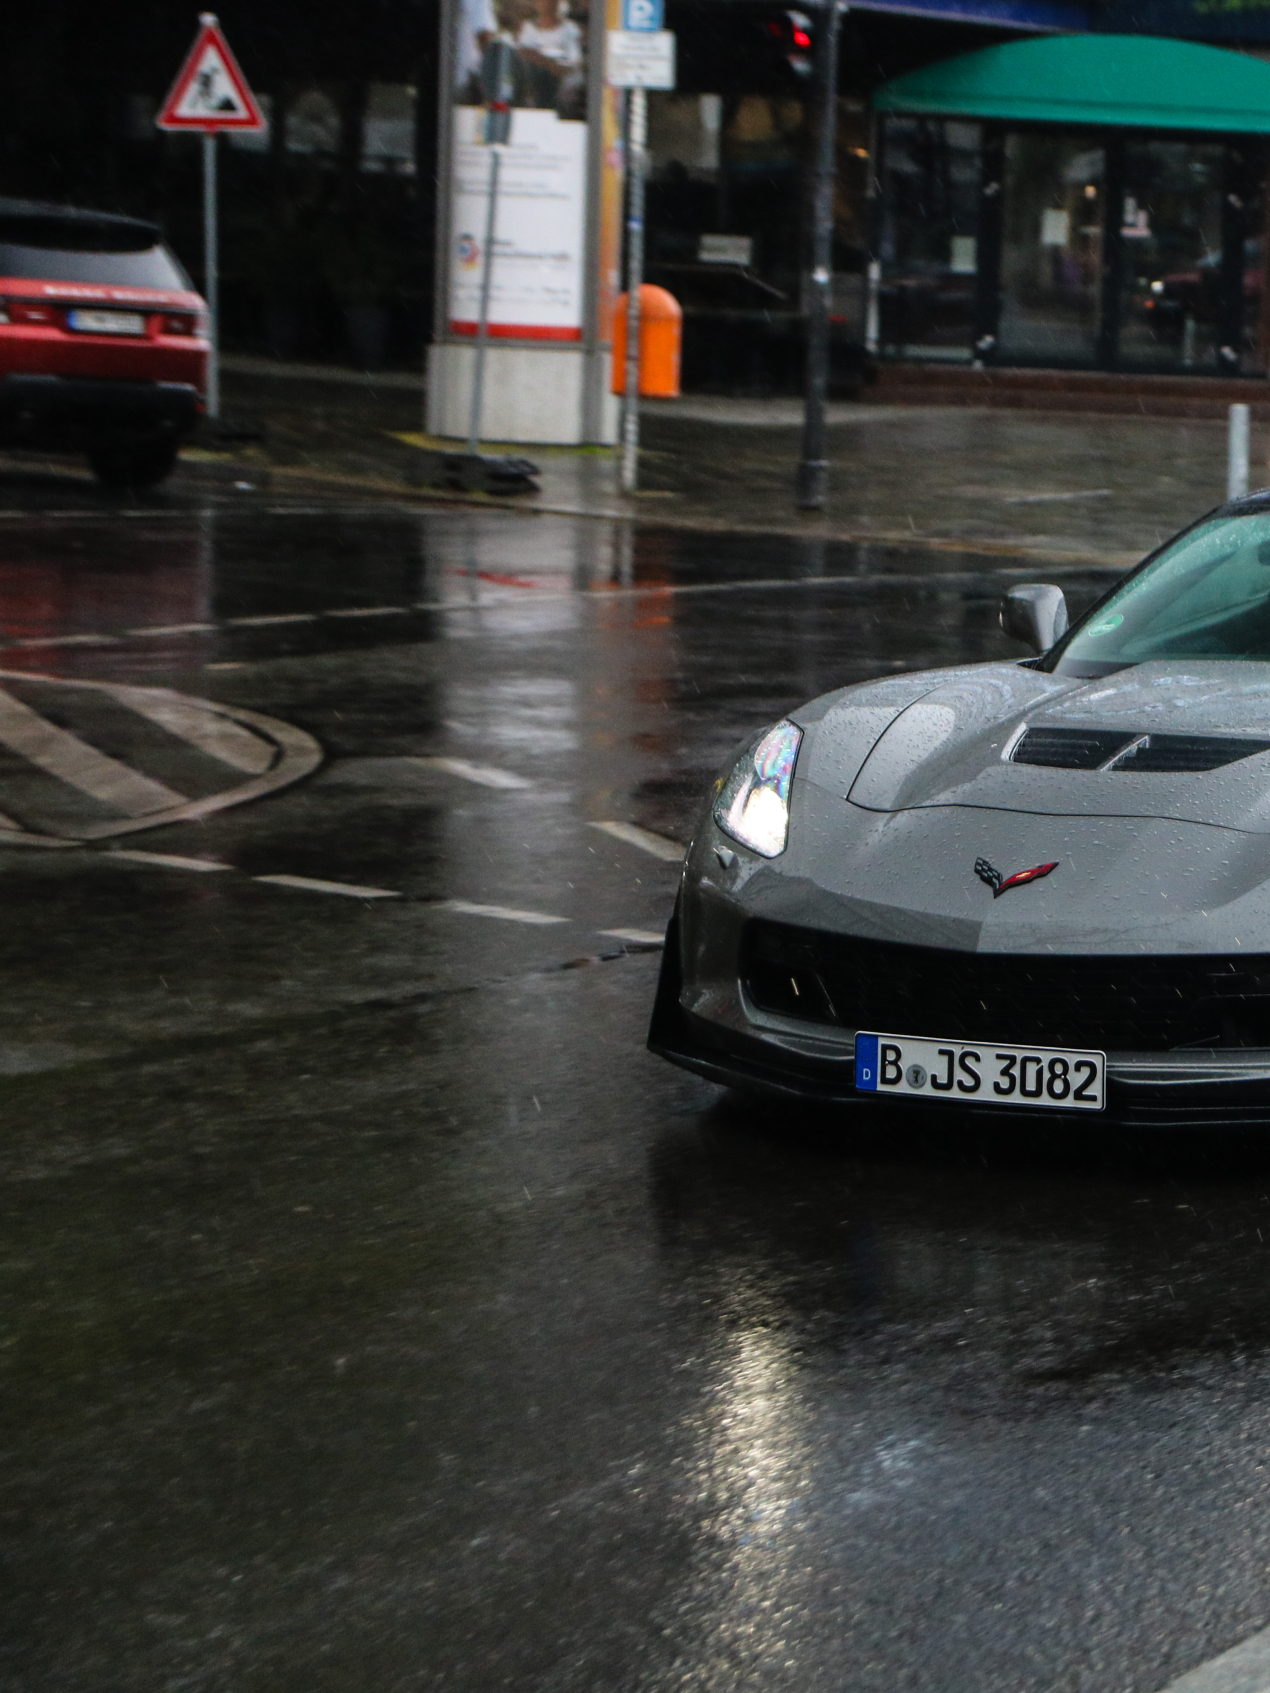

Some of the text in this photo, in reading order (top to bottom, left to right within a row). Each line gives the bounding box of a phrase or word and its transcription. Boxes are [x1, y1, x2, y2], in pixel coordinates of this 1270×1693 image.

[862, 1068, 871, 1081] D
[880, 1043, 1098, 1102] B JS 3082
